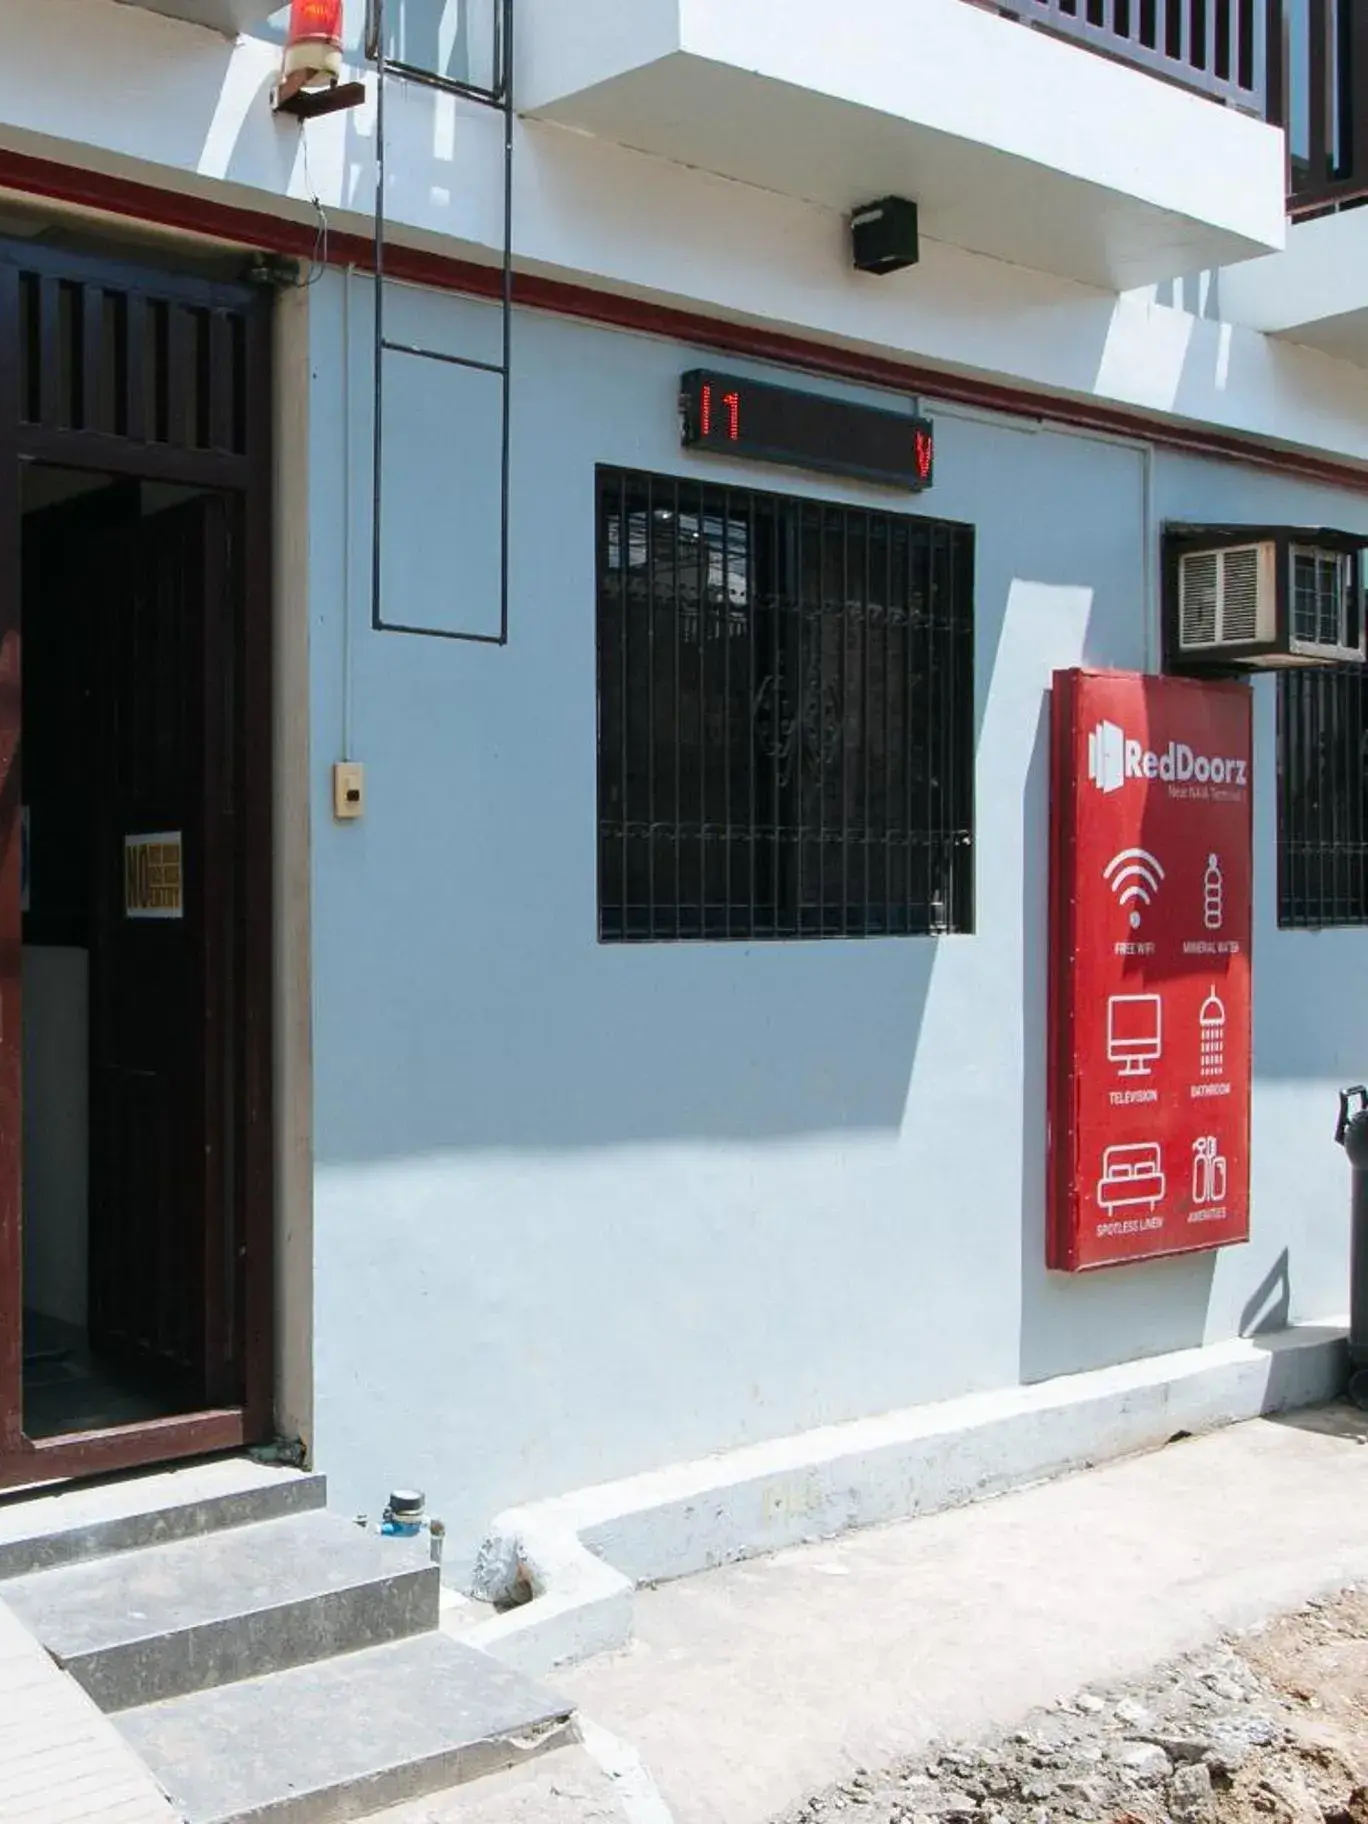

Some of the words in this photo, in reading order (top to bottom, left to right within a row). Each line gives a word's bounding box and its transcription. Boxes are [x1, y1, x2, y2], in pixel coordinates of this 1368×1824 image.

[1125, 739, 1247, 786] RedDoorz
[1114, 941, 1136, 955] FREE
[1182, 941, 1216, 954] MINERAL
[1109, 1089, 1157, 1105] TELEVISION
[1096, 1220, 1138, 1237] SPOTLESS
